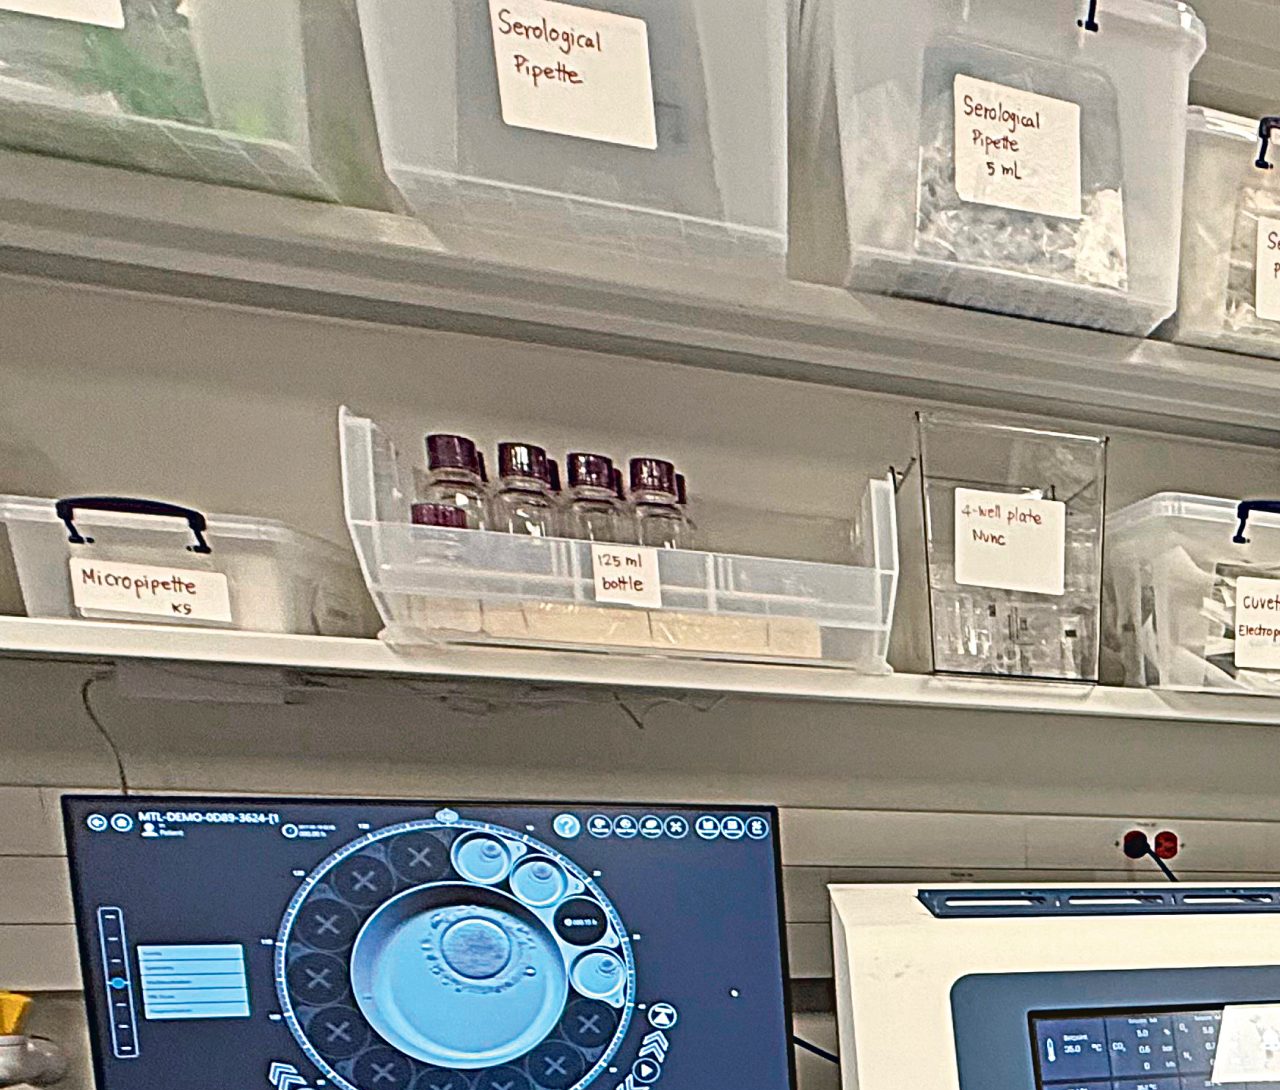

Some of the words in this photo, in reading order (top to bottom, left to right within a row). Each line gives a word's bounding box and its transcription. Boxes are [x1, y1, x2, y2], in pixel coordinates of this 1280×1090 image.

[498, 9, 601, 54] Serological
[514, 54, 583, 86] Pipette
[963, 95, 1040, 133] Serological
[972, 129, 1019, 154] Pipette
[986, 161, 996, 176] 5
[1007, 507, 1042, 525] plate
[972, 528, 1006, 546] Nunc
[598, 553, 621, 567] 125
[82, 568, 197, 599] Micropipette
[602, 576, 644, 591] bottle
